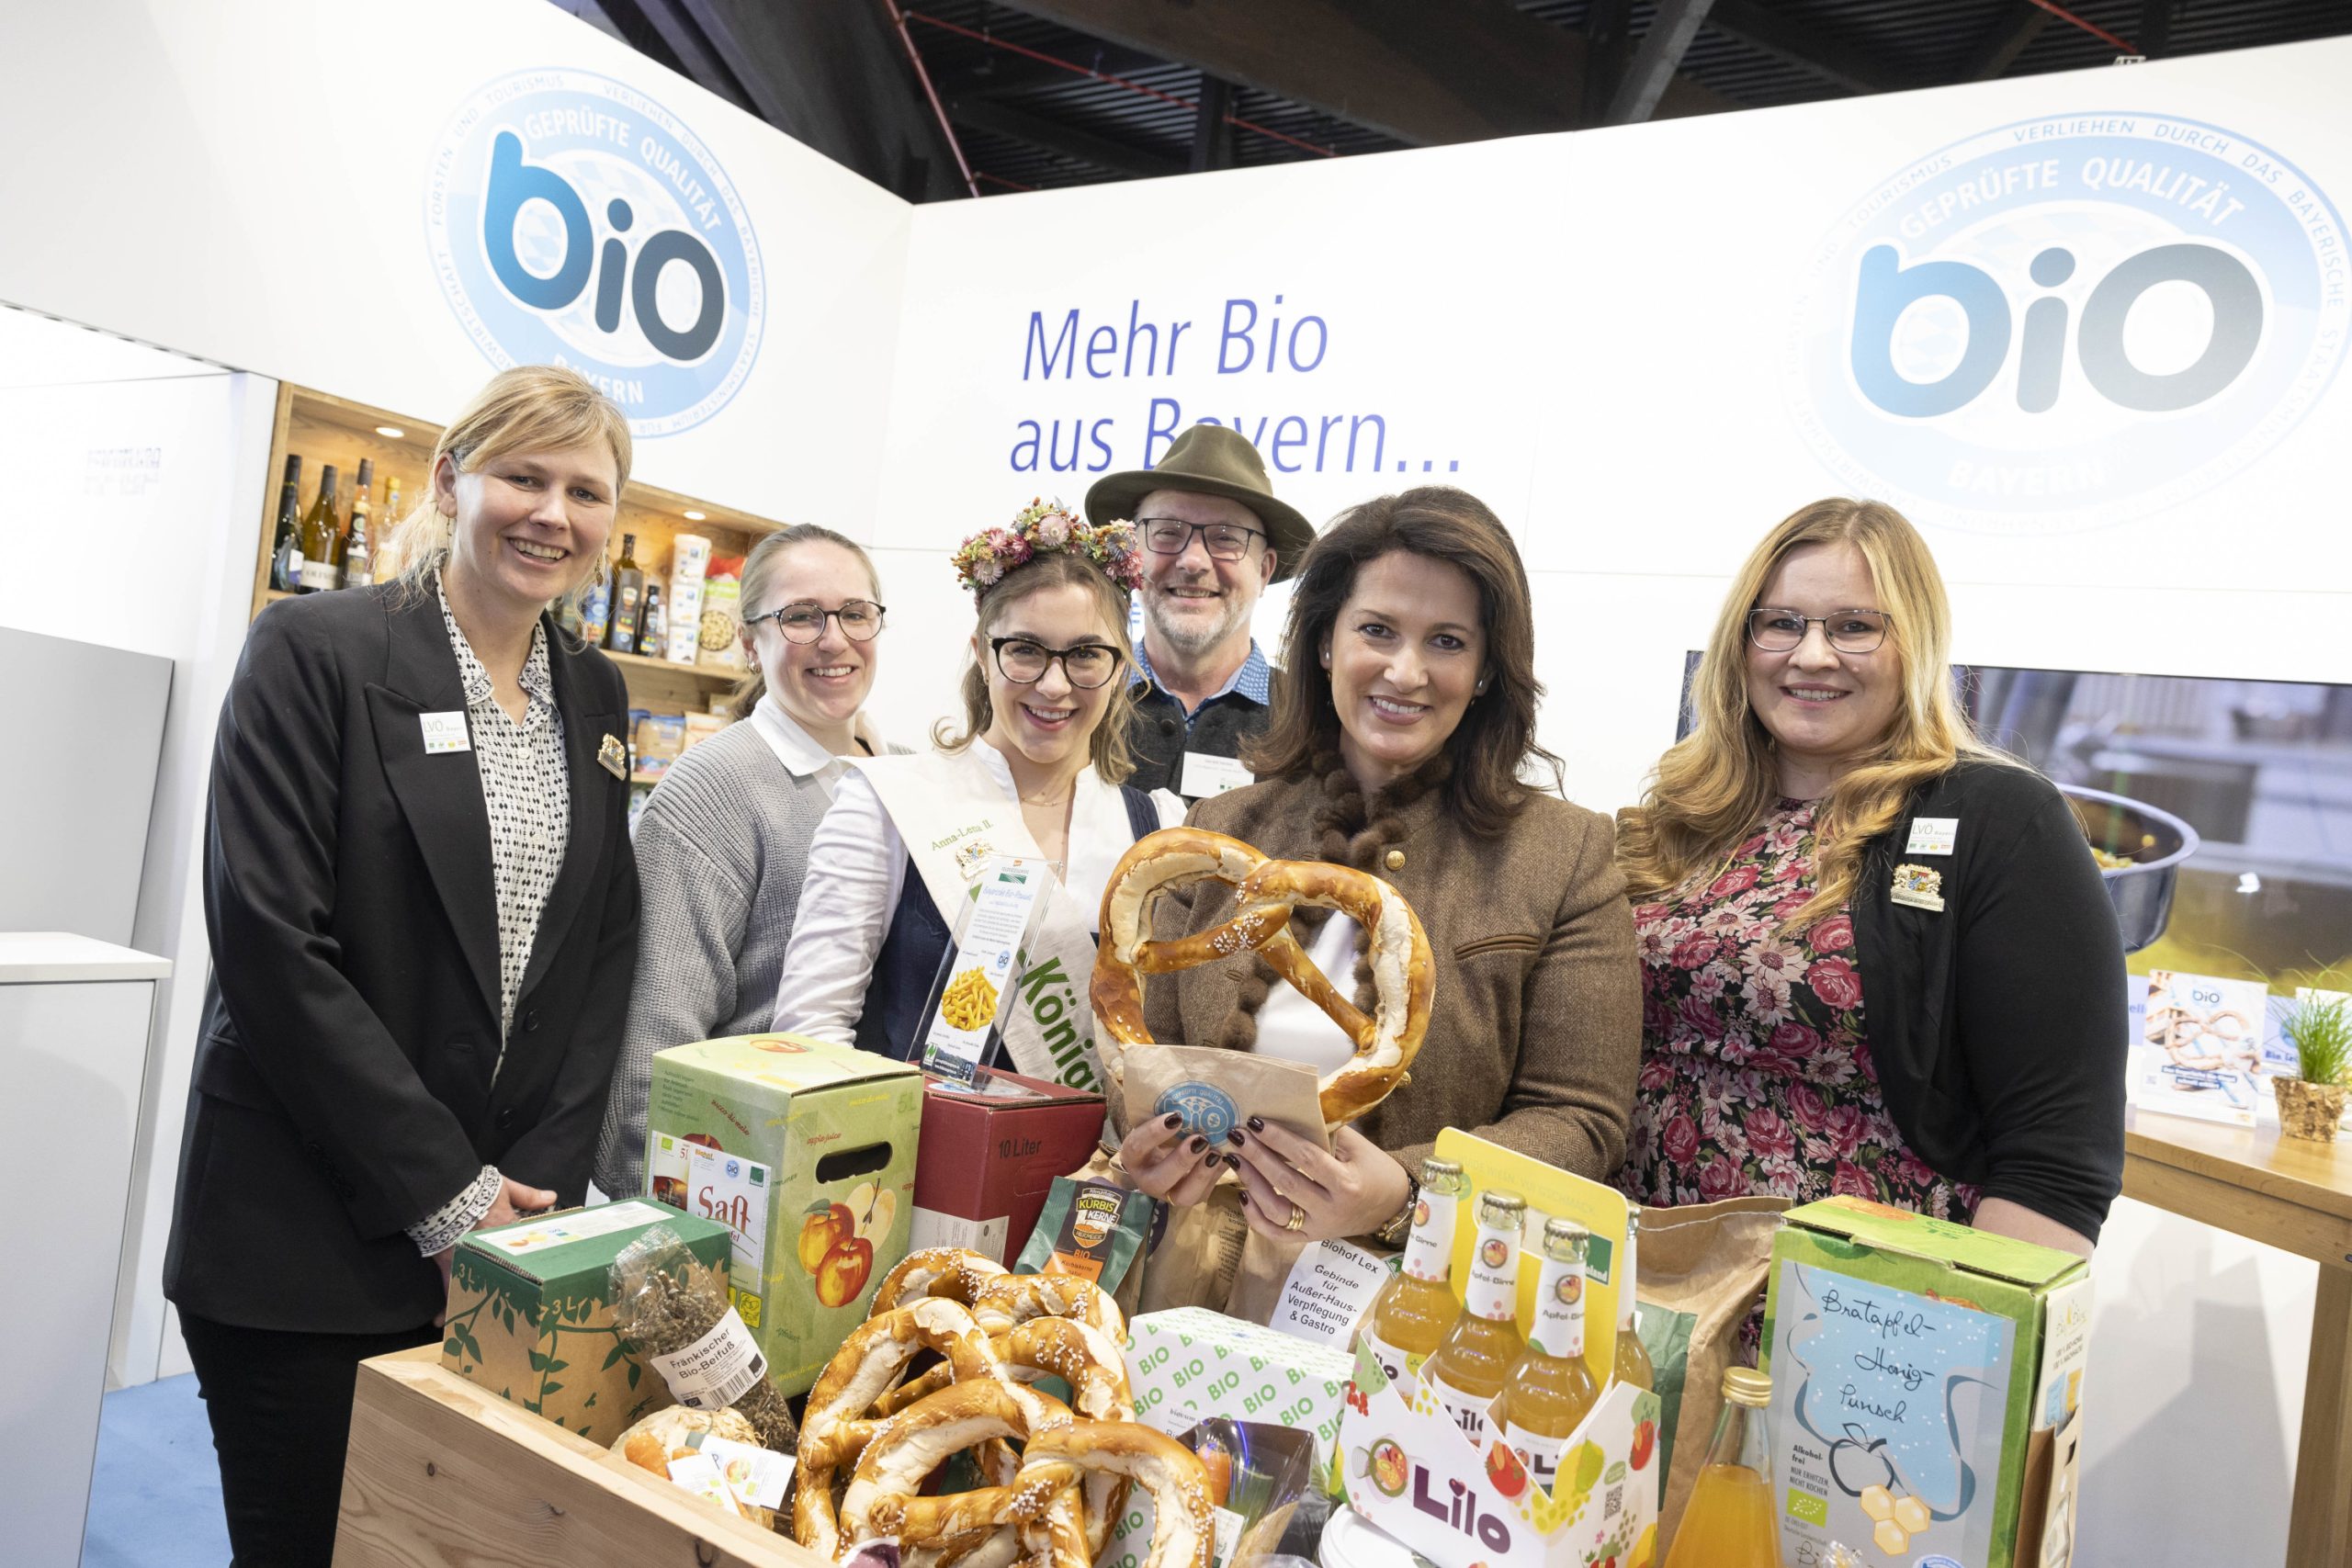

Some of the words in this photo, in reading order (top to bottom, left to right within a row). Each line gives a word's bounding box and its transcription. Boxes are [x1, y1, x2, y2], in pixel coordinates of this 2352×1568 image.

[485, 74, 564, 104] TOURISMUS
[454, 108, 479, 139] UND
[603, 84, 673, 130] VERLIEHEN
[682, 134, 718, 177] DURCH
[525, 106, 631, 147] GEPRÜFTE
[640, 137, 721, 232] QUALITÄT
[1846, 153, 1953, 229] TOURISMUS
[1899, 159, 2060, 239] GEPRÜFTE
[2082, 155, 2246, 227] QUALITÄT
[2014, 119, 2136, 143] VERLIEHEN
[2154, 123, 2231, 155] DURCH
[2242, 152, 2283, 185] DAS
[2288, 189, 2345, 309] BAYERISCHE
[1023, 299, 1192, 381] Mehr
[1216, 295, 1329, 375] Bio
[1011, 418, 1114, 473] aus
[1143, 398, 1459, 473] Bern...
[1947, 461, 2106, 496] BAYERN
[932, 825, 983, 852] Anna-Lena
[999, 1139, 1011, 1159] 10
[1013, 1137, 1042, 1157] Liter
[698, 1186, 751, 1235] Saft
[1079, 1197, 1115, 1213] KÜRBIS
[1088, 1211, 1117, 1224] KERNE
[1074, 1249, 1091, 1260] BIO
[1320, 1239, 1359, 1262] Biohof
[1358, 1257, 1379, 1274] Lex
[458, 1263, 466, 1278] 3
[468, 1269, 475, 1284] L
[1315, 1264, 1360, 1290] Gebinde
[1322, 1280, 1340, 1292] für
[552, 1302, 561, 1314] 3
[1288, 1293, 1350, 1326] Verpflegung
[1291, 1281, 1358, 1314] Außer-Haus-
[1290, 1311, 1297, 1322] &
[1301, 1314, 1336, 1335] Gastro
[1821, 1289, 1937, 1339] Bratapfel-
[669, 1327, 730, 1370] Fränkischer
[679, 1340, 735, 1380] Bio-Beifuß
[1138, 1347, 1170, 1376] BIO
[1172, 1359, 1204, 1389] BIO
[1854, 1347, 1936, 1391] Honig-
[1134, 1387, 1163, 1417] BIO
[1207, 1371, 1240, 1402] BIO
[1243, 1383, 1277, 1415] BIO
[1279, 1397, 1314, 1427] BIO
[1839, 1383, 1908, 1425] Punsch
[1792, 1454, 1805, 1465] frei
[1793, 1444, 1823, 1461] Alkohol-
[1790, 1466, 1803, 1475] NUR
[1790, 1476, 1805, 1488] NICHT
[1806, 1483, 1828, 1497] KOCHEN
[1413, 1464, 1510, 1554] Lilo
[1115, 1511, 1144, 1541] BIO
